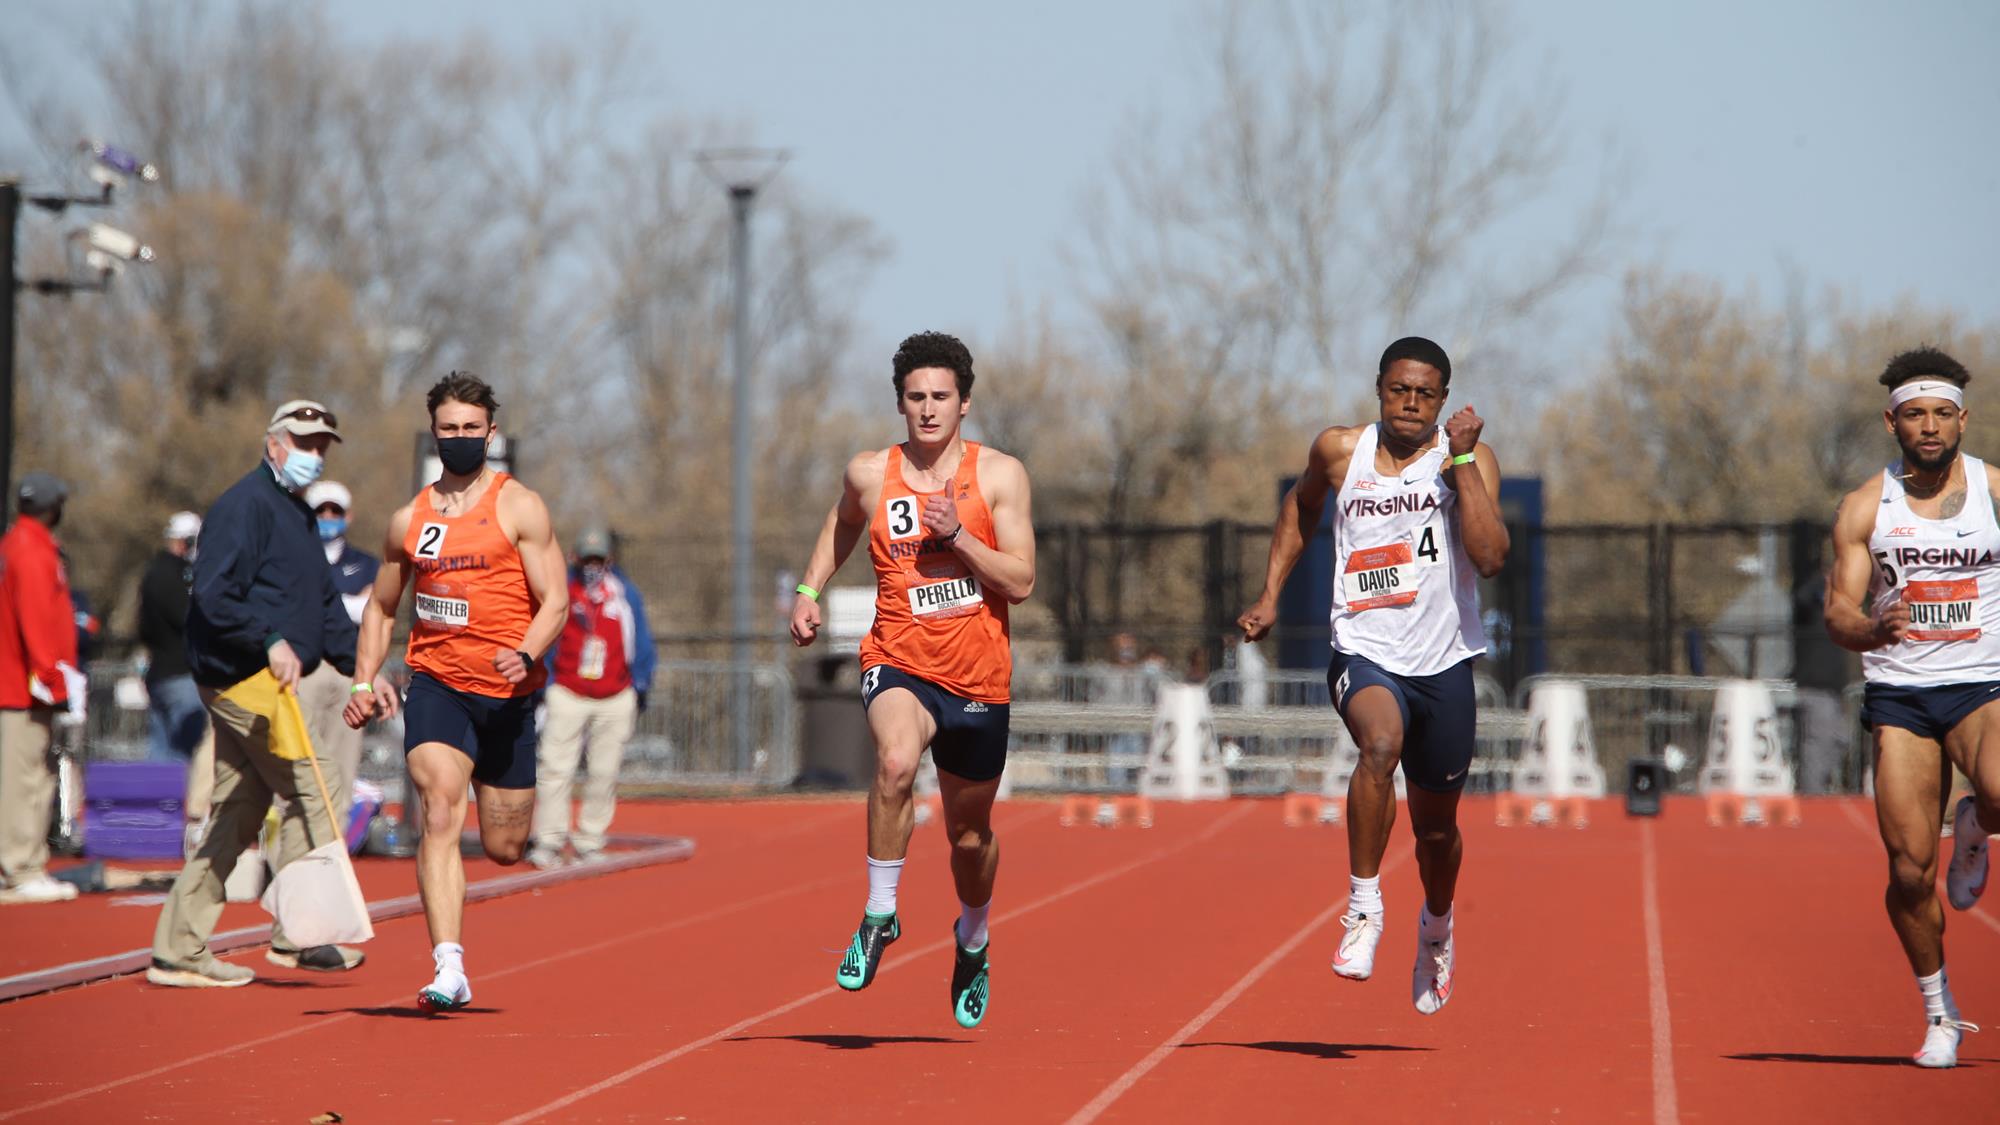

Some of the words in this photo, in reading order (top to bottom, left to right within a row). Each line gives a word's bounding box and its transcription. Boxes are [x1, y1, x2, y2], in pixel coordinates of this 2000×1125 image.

[1353, 480, 1376, 490] ACC
[890, 499, 913, 535] 3
[1344, 493, 1439, 517] VIRGINIA
[419, 526, 441, 555] 2
[1417, 526, 1439, 562] 4
[1888, 527, 1917, 535] ACC
[1874, 551, 1898, 588] 5
[1895, 548, 1995, 567] IRGINIA
[916, 577, 976, 607] PERELLO
[1358, 567, 1400, 593] DAVIS
[963, 705, 989, 713] adidas
